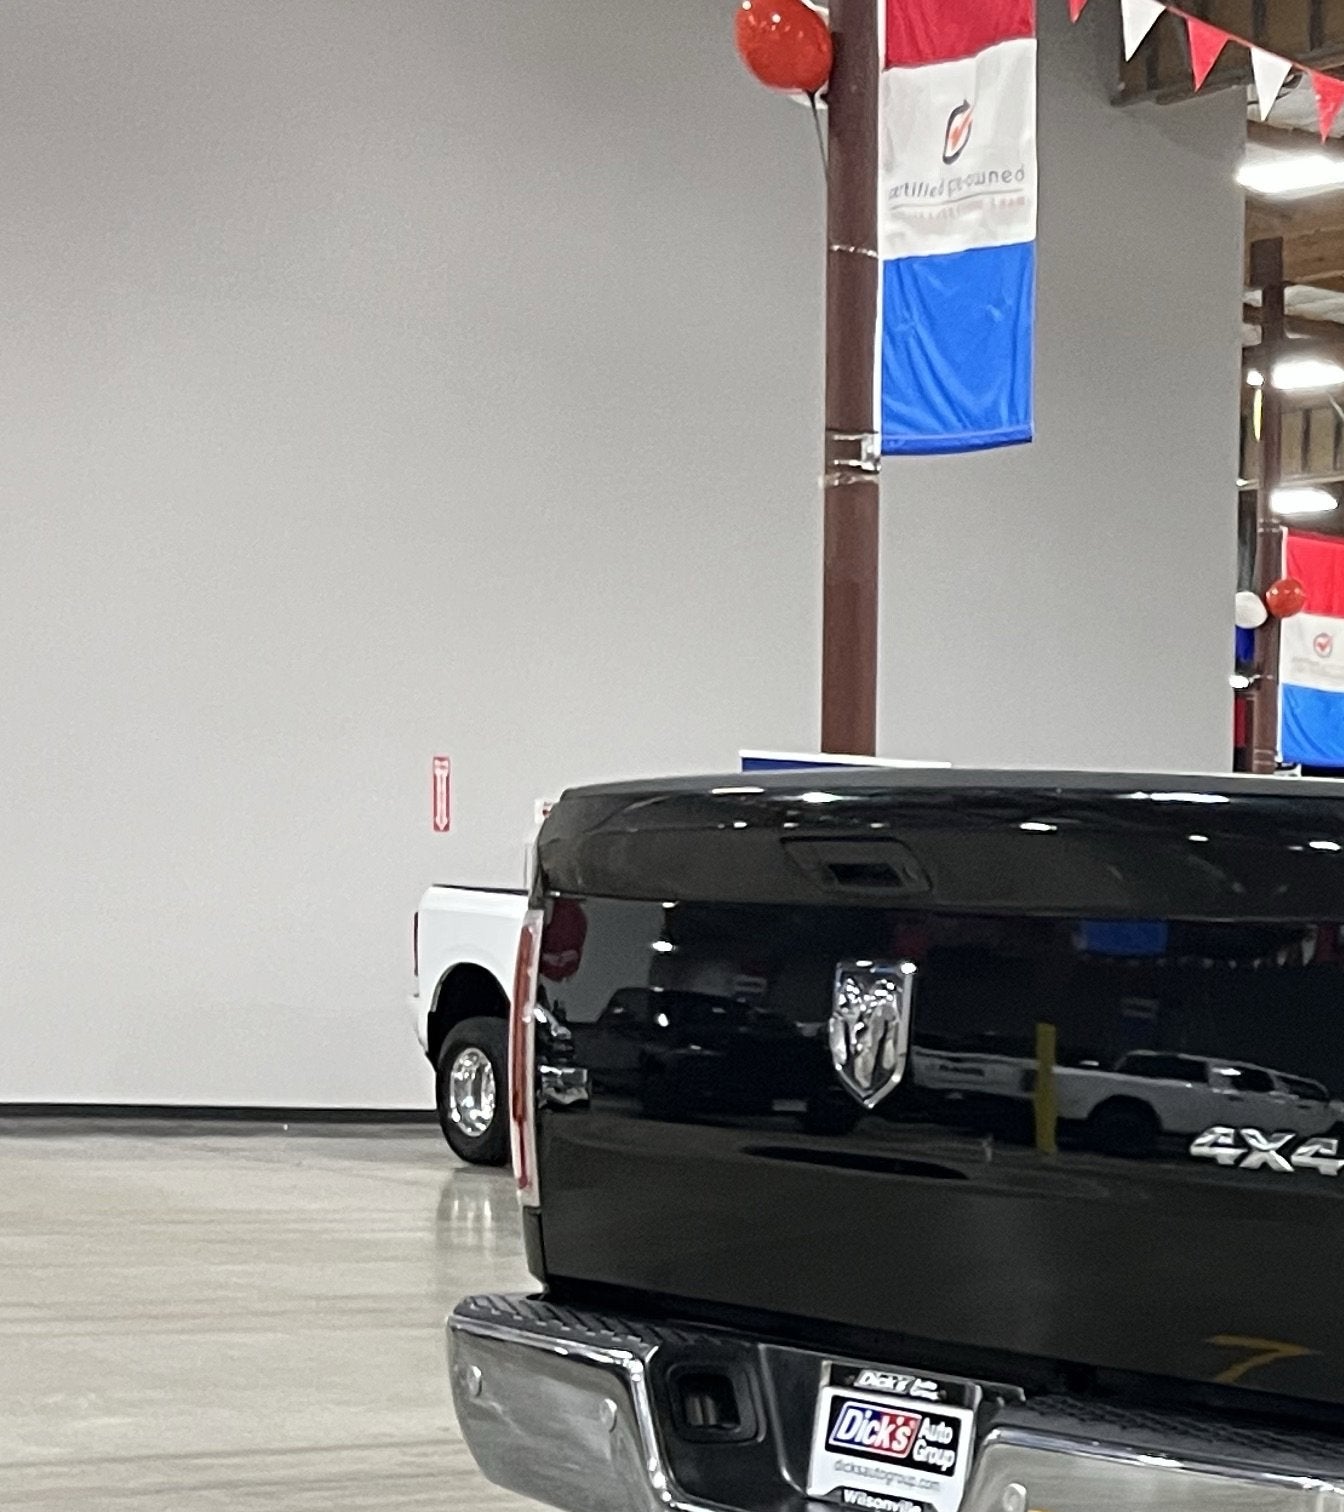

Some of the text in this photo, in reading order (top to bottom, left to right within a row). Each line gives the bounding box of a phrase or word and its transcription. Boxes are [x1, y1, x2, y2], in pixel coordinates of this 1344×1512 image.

[837, 1408, 953, 1452] Dick's Auto
[913, 1439, 955, 1471] Group
